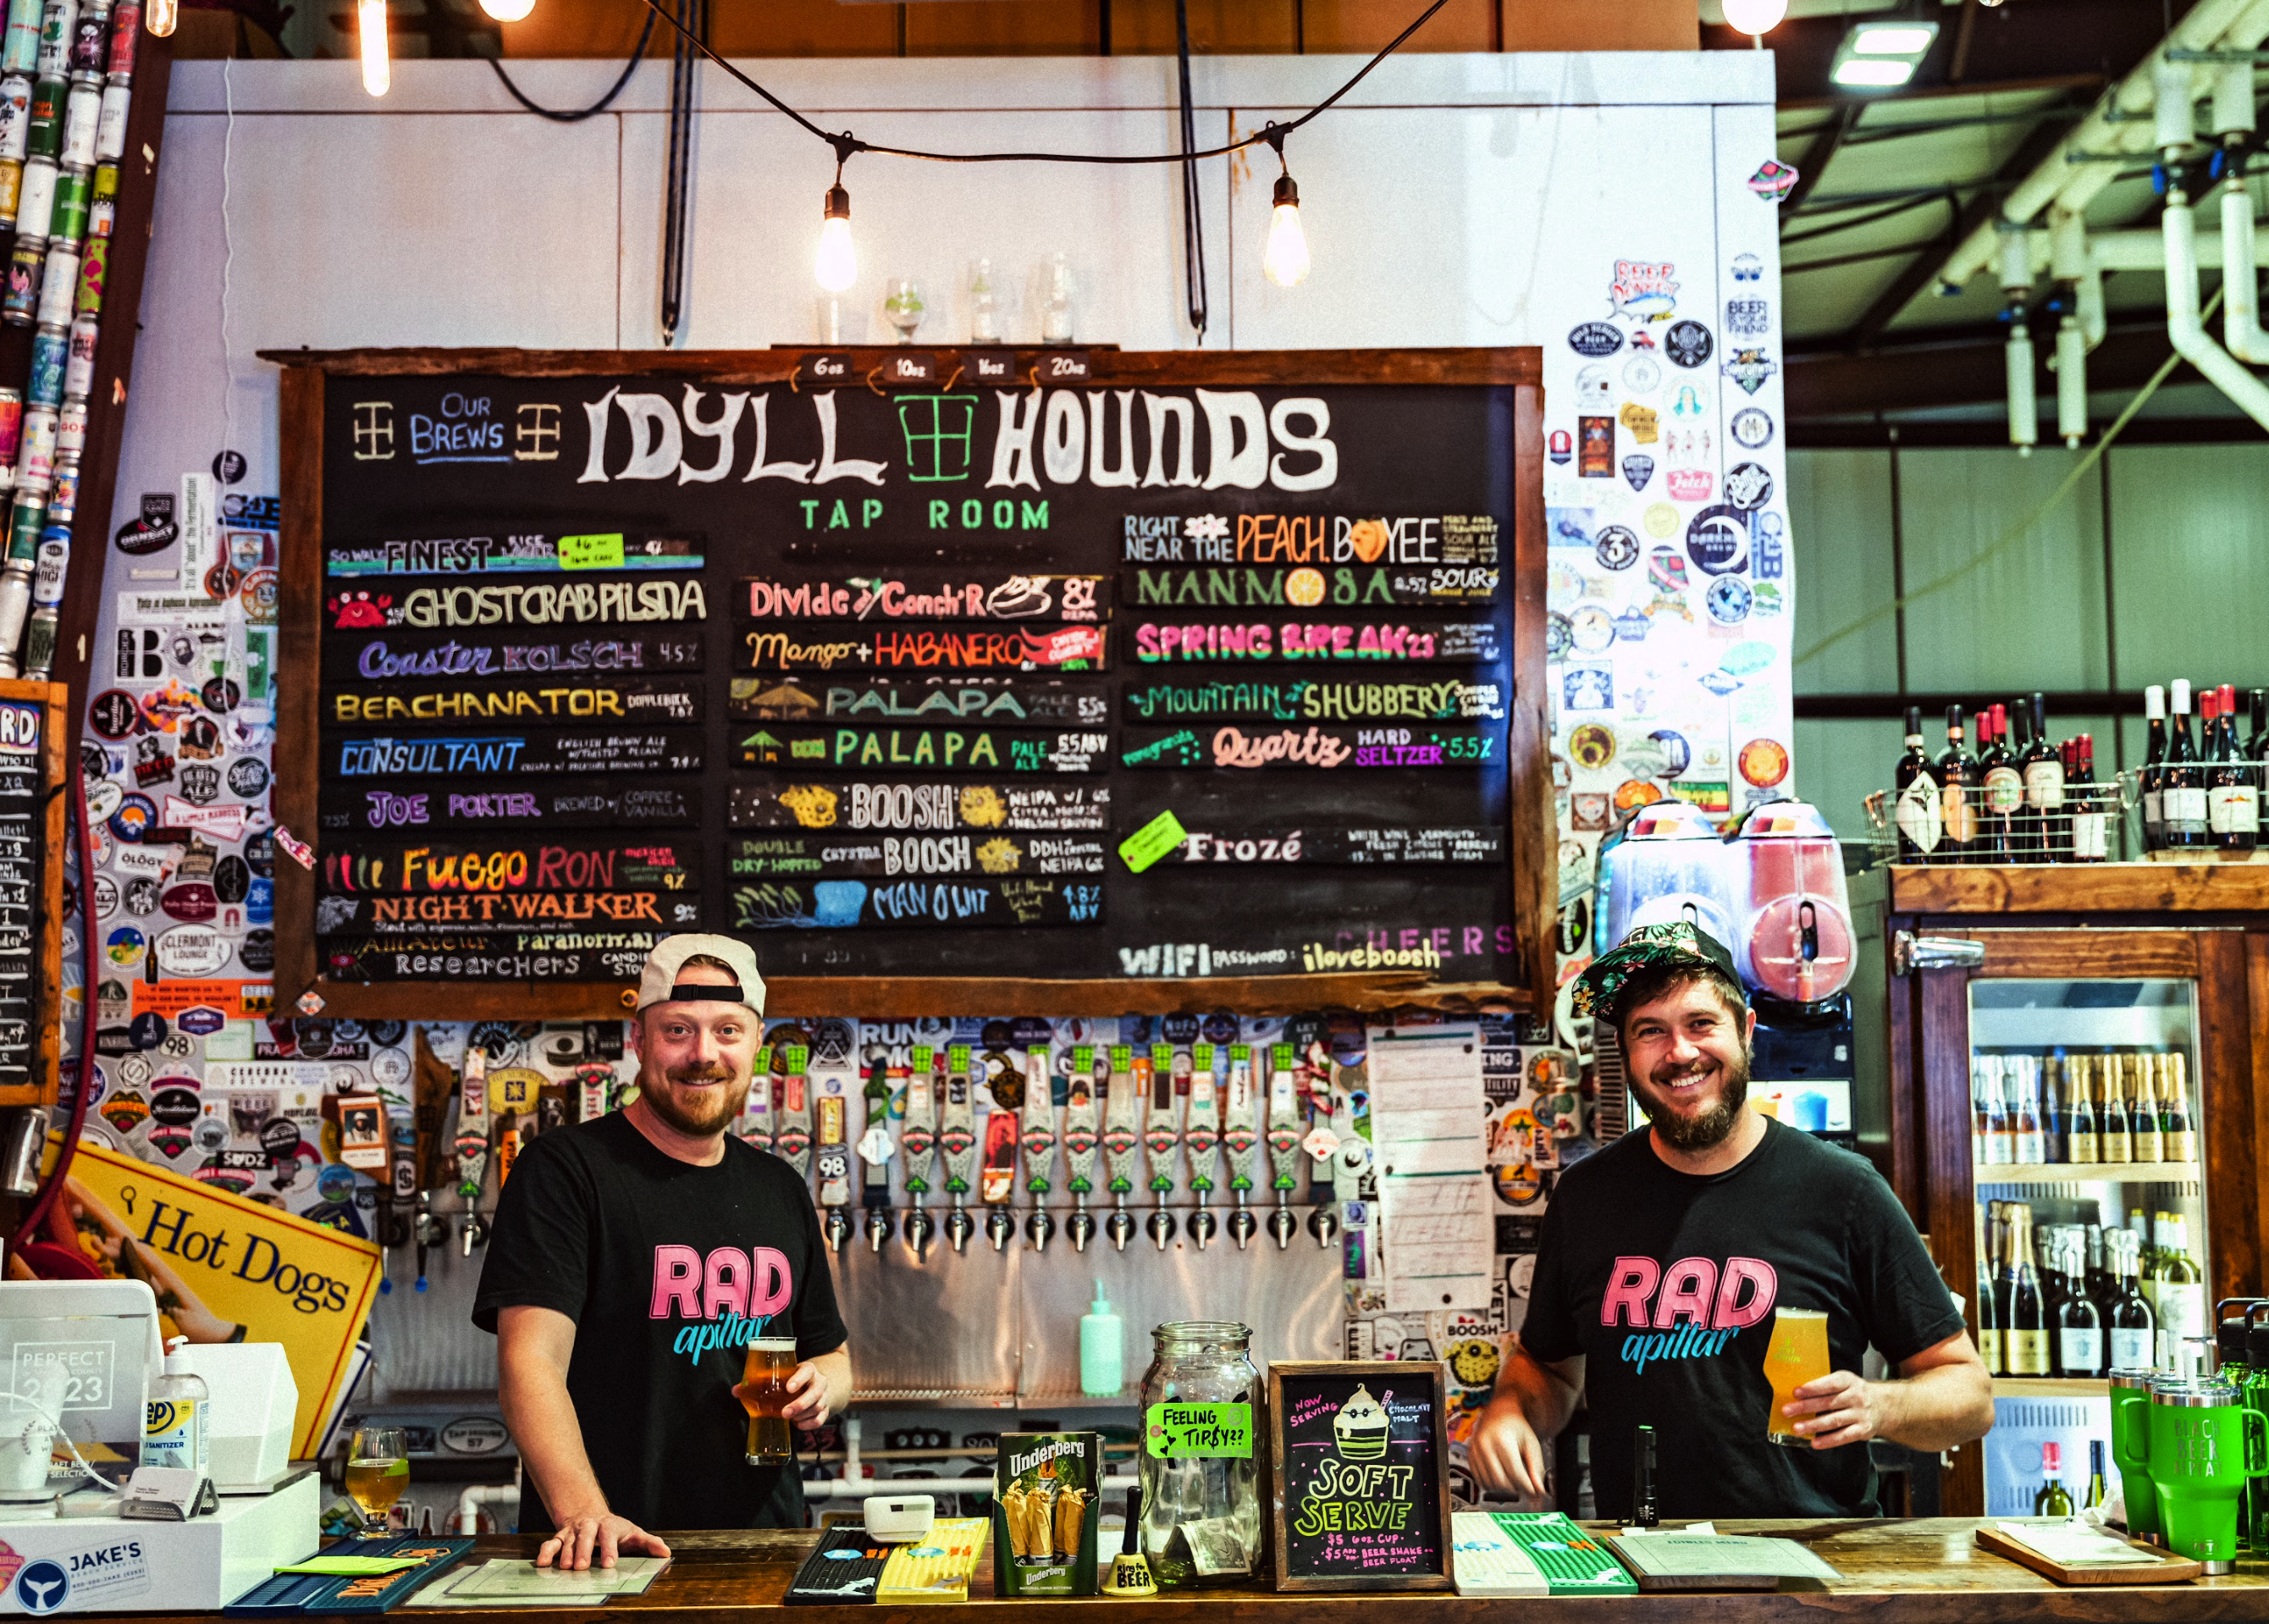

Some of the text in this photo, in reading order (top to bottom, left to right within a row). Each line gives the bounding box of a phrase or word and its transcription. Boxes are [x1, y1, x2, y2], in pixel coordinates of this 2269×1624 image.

[1729, 301, 1767, 313] BEER
[410, 414, 505, 454] BREWS
[577, 384, 1339, 492] IDYLL HOUNDS
[800, 499, 1051, 530] TAP ROOM
[1125, 516, 1180, 539] RIGHT
[384, 536, 493, 573] FINEST
[1125, 538, 1234, 561] NEAR THE
[1334, 516, 1440, 564] BYEE
[751, 582, 848, 617] Divide
[1138, 567, 1395, 606] MANMSA
[747, 632, 857, 670] Mango
[875, 632, 1025, 667] HABANERO
[1136, 623, 1272, 662] SPRING
[1281, 623, 1409, 660] BREAK
[359, 641, 499, 677] Coaster
[503, 641, 643, 671] KOLSCH
[335, 688, 625, 722] BEACHANATOR
[826, 688, 1026, 718] PALAPA
[1143, 680, 1460, 720] MOUNTAIN SHUBBERY
[645, 736, 667, 747] ALE
[835, 730, 999, 765] PALAPA
[1011, 740, 1047, 758] PALE
[1213, 726, 1351, 768] Quartz
[1358, 729, 1411, 745] HARD
[340, 742, 525, 776] CONSULTANT
[1015, 757, 1040, 770] ALE
[1356, 746, 1443, 765] SELTZER
[366, 792, 429, 828] JOE
[449, 792, 542, 818] PORTER
[554, 796, 605, 813] BREWED
[625, 804, 687, 818] VANILLA
[851, 783, 954, 830] BOOSH
[1009, 789, 1057, 807] NEIPA
[743, 839, 805, 855] DOUBLE
[883, 837, 971, 875] BOOSH
[1184, 831, 1302, 862] Frozé
[402, 847, 528, 892] Fuego
[535, 846, 617, 889] RON
[1041, 857, 1084, 874] NEIPA
[371, 893, 501, 923] NIGHT
[506, 892, 663, 925] WALKER
[873, 882, 927, 920] MAN
[1119, 942, 1210, 976] WIFI
[1302, 937, 1440, 971] iloveboosh
[165, 1036, 189, 1056] 98
[1482, 1052, 1514, 1067] ING
[819, 1157, 847, 1177] 98
[137, 1200, 351, 1313] Hot Dogs
[649, 1245, 792, 1320] RAD
[1600, 1256, 1778, 1330] RAD
[673, 1312, 772, 1366] apillar
[1448, 1324, 1498, 1336] BOOSH
[1620, 1321, 1741, 1376] apillar
[22, 1376, 103, 1402] 223
[1295, 1394, 1322, 1412] NOW
[147, 1401, 167, 1424] ep
[1163, 1409, 1217, 1425] FEELING
[1290, 1401, 1339, 1428] SERVING
[1393, 1415, 1420, 1423] MALT
[1009, 1439, 1085, 1478] Underberg
[1308, 1458, 1414, 1500] SOFT
[1294, 1495, 1413, 1536] SERVE
[1361, 1548, 1388, 1559] BEER
[1390, 1546, 1422, 1555] SHAKE
[1377, 1533, 1399, 1544] CUP
[70, 1542, 141, 1572] JAKE'S
[1362, 1558, 1387, 1567] BEER
[1026, 1567, 1066, 1586] Underberg
[1117, 1572, 1151, 1588] BEER
